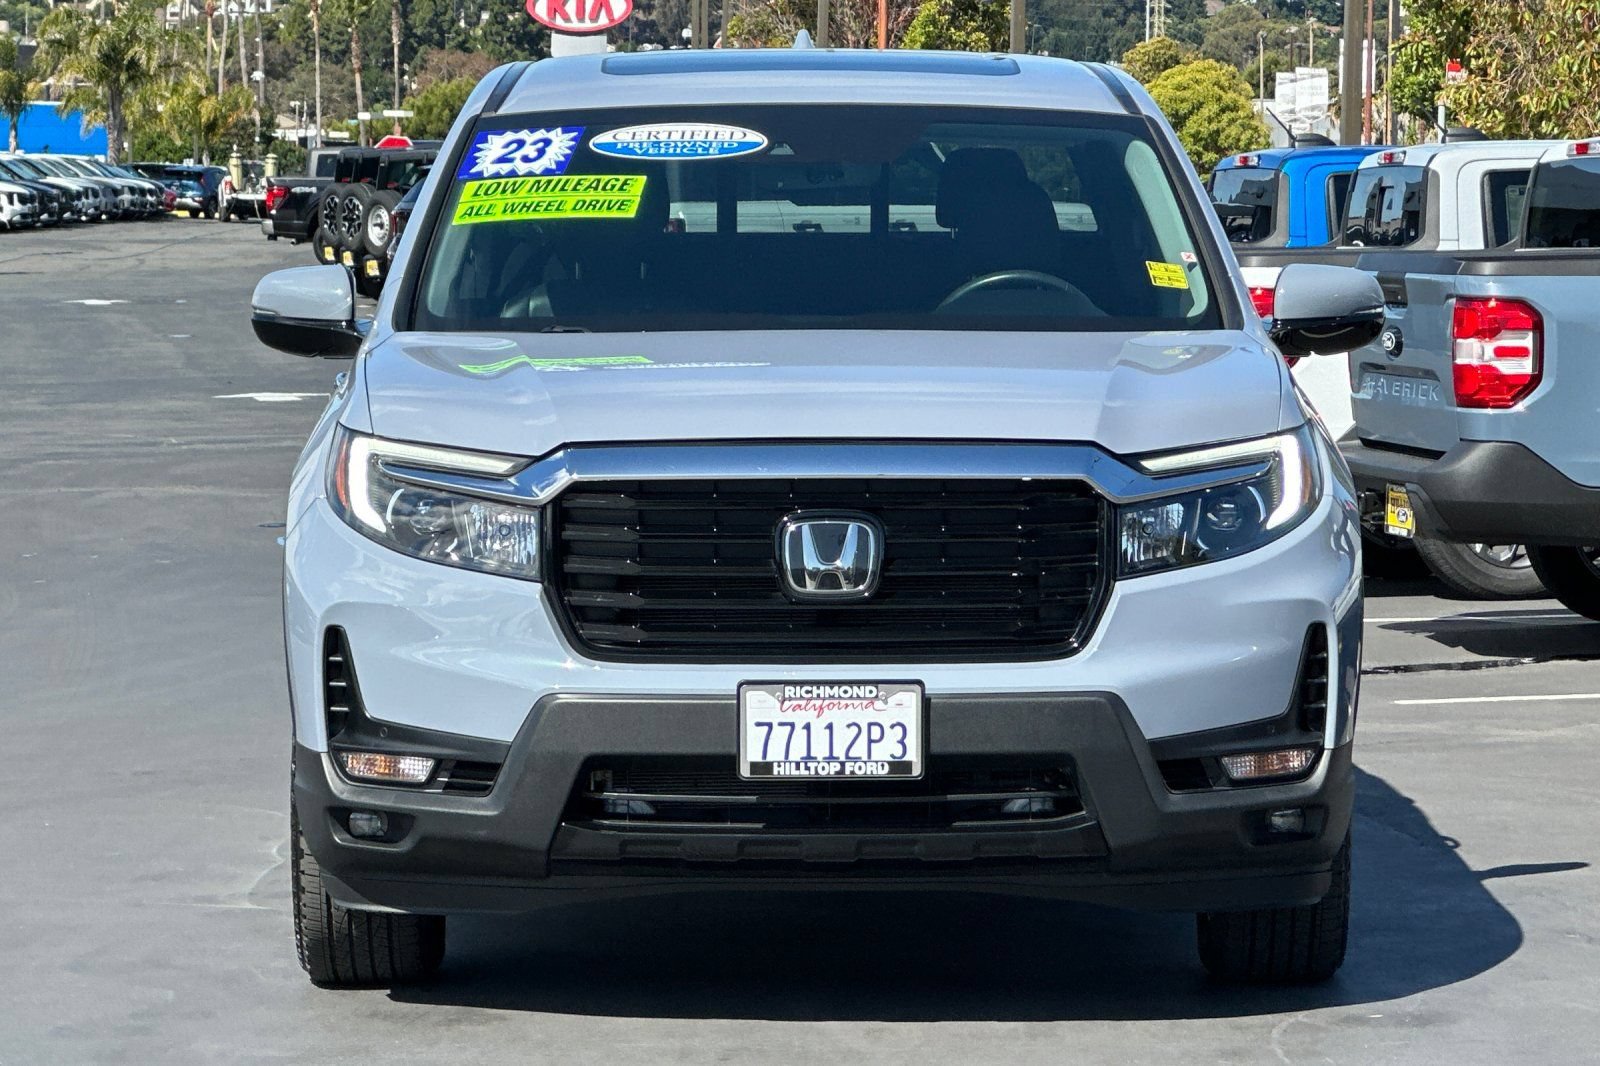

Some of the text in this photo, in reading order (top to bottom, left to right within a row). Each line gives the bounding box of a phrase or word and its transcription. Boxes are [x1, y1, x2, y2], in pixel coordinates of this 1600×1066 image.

[546, 0, 615, 22] KIA
[612, 129, 747, 141] CERTIFIED
[616, 141, 739, 149] PRE-OWNED
[489, 137, 553, 164] 23
[471, 177, 636, 198] LOW MILEAGE
[459, 199, 634, 219] ALL WHEEL DRIVE
[784, 685, 877, 698] RICHMOND
[779, 698, 887, 718] California
[754, 721, 908, 760] 77112P3
[773, 761, 890, 775] HILLTOP FORD
